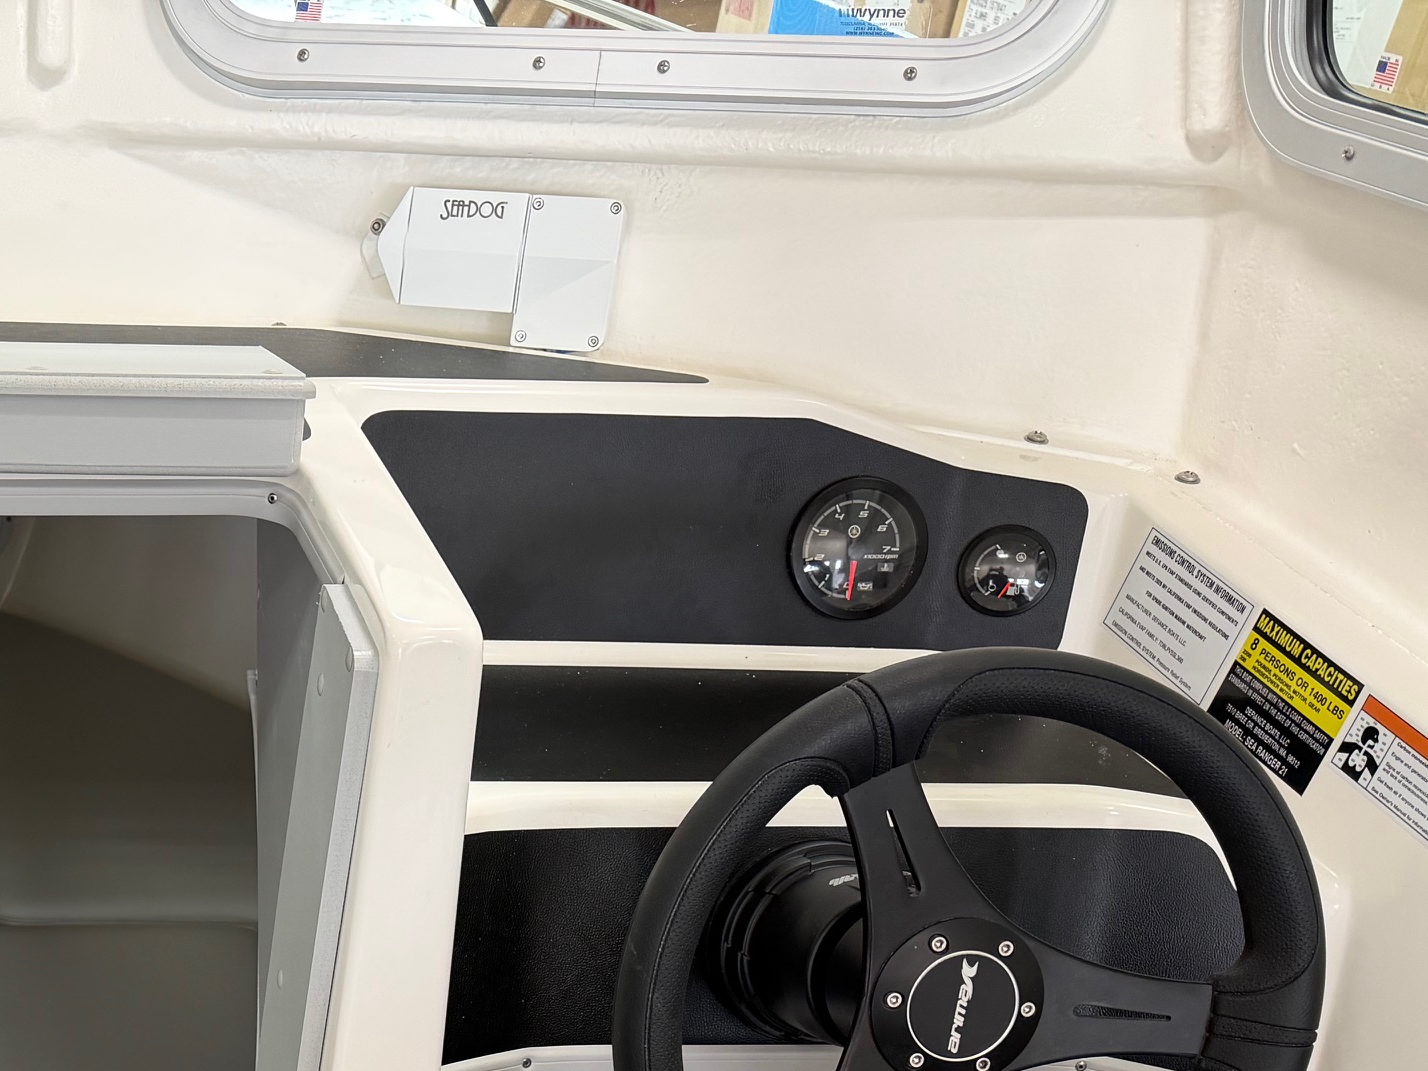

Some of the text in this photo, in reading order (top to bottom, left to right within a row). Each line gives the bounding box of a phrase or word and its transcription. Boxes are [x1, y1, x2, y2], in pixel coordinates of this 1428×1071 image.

[1150, 535, 1246, 614] EMISSIONS CONTROL SYSTEM INFORMATION
[1151, 614, 1168, 631] DEFIANCE
[1166, 627, 1179, 640] BOATS
[1255, 613, 1359, 701] MAXIMUM CAPACITIES
[1249, 637, 1345, 720] 8 PERSONS OR 1400 LBS
[1223, 718, 1288, 776] MODEL: SEA RANGER 21
[1243, 706, 1290, 747] DEFIANCE BOATS, LLC
